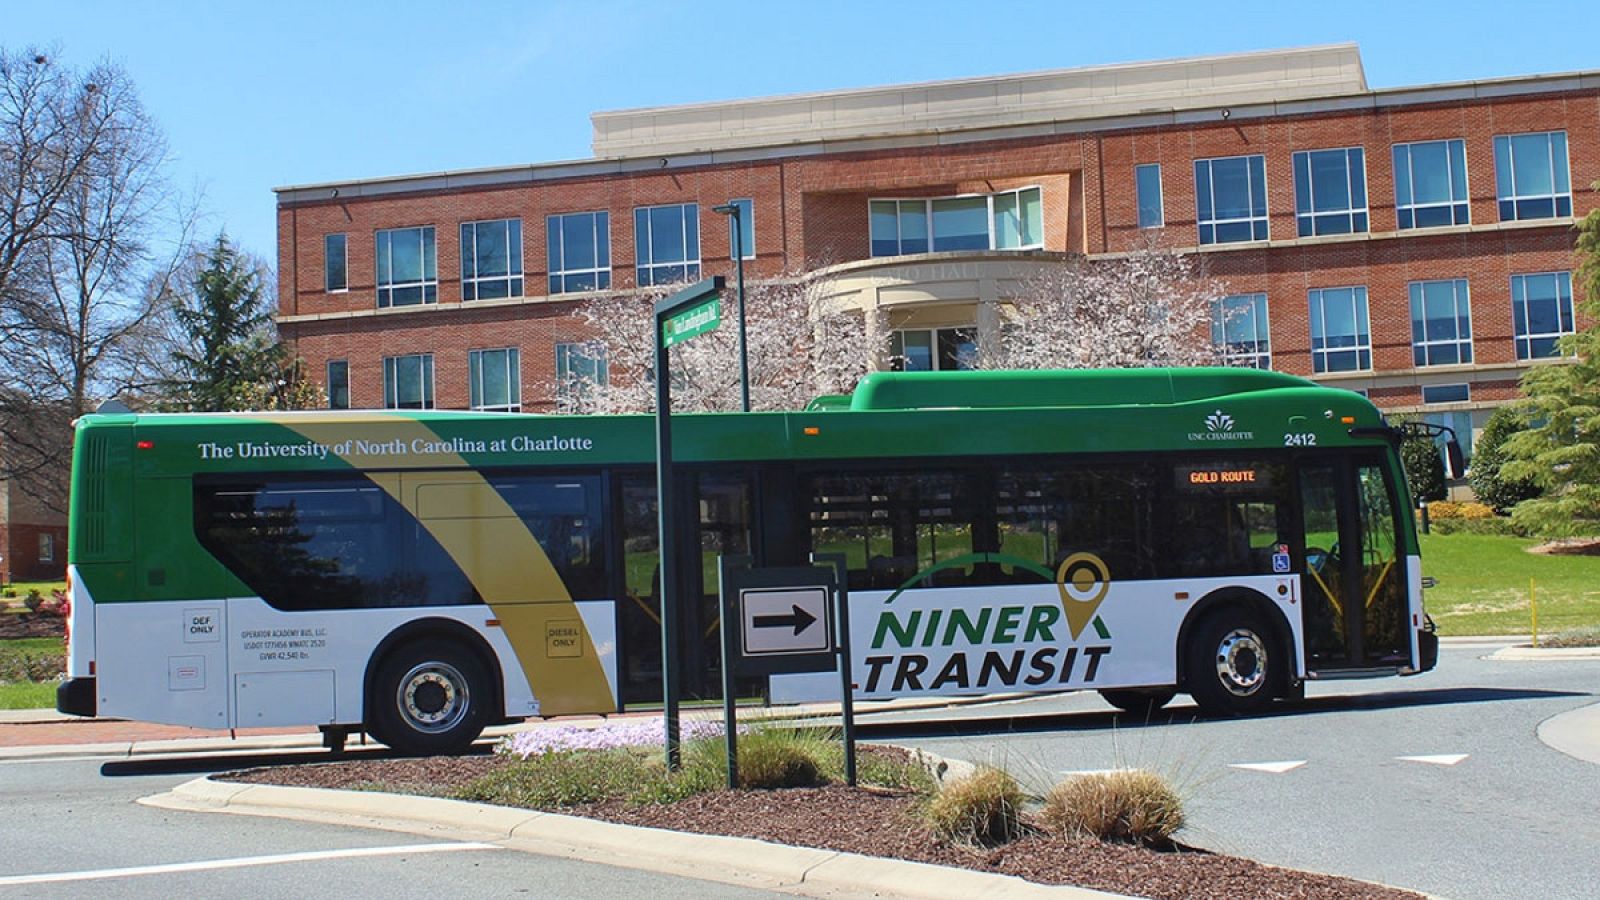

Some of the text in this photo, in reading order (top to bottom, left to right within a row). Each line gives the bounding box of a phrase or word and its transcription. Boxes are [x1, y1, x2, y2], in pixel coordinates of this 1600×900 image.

[1188, 431, 1254, 441] UNC CHARLOTTE
[1284, 432, 1317, 447] 2412
[197, 435, 593, 461] The University of North Carolina at Charlotte
[1190, 470, 1256, 484] GOLD ROUTE
[193, 616, 211, 626] DEF
[870, 604, 1061, 650] NINER
[190, 624, 214, 635] ONLY
[548, 627, 579, 637] DIESEL
[552, 638, 576, 648] ONLY
[863, 645, 1113, 694] TRANSIT
